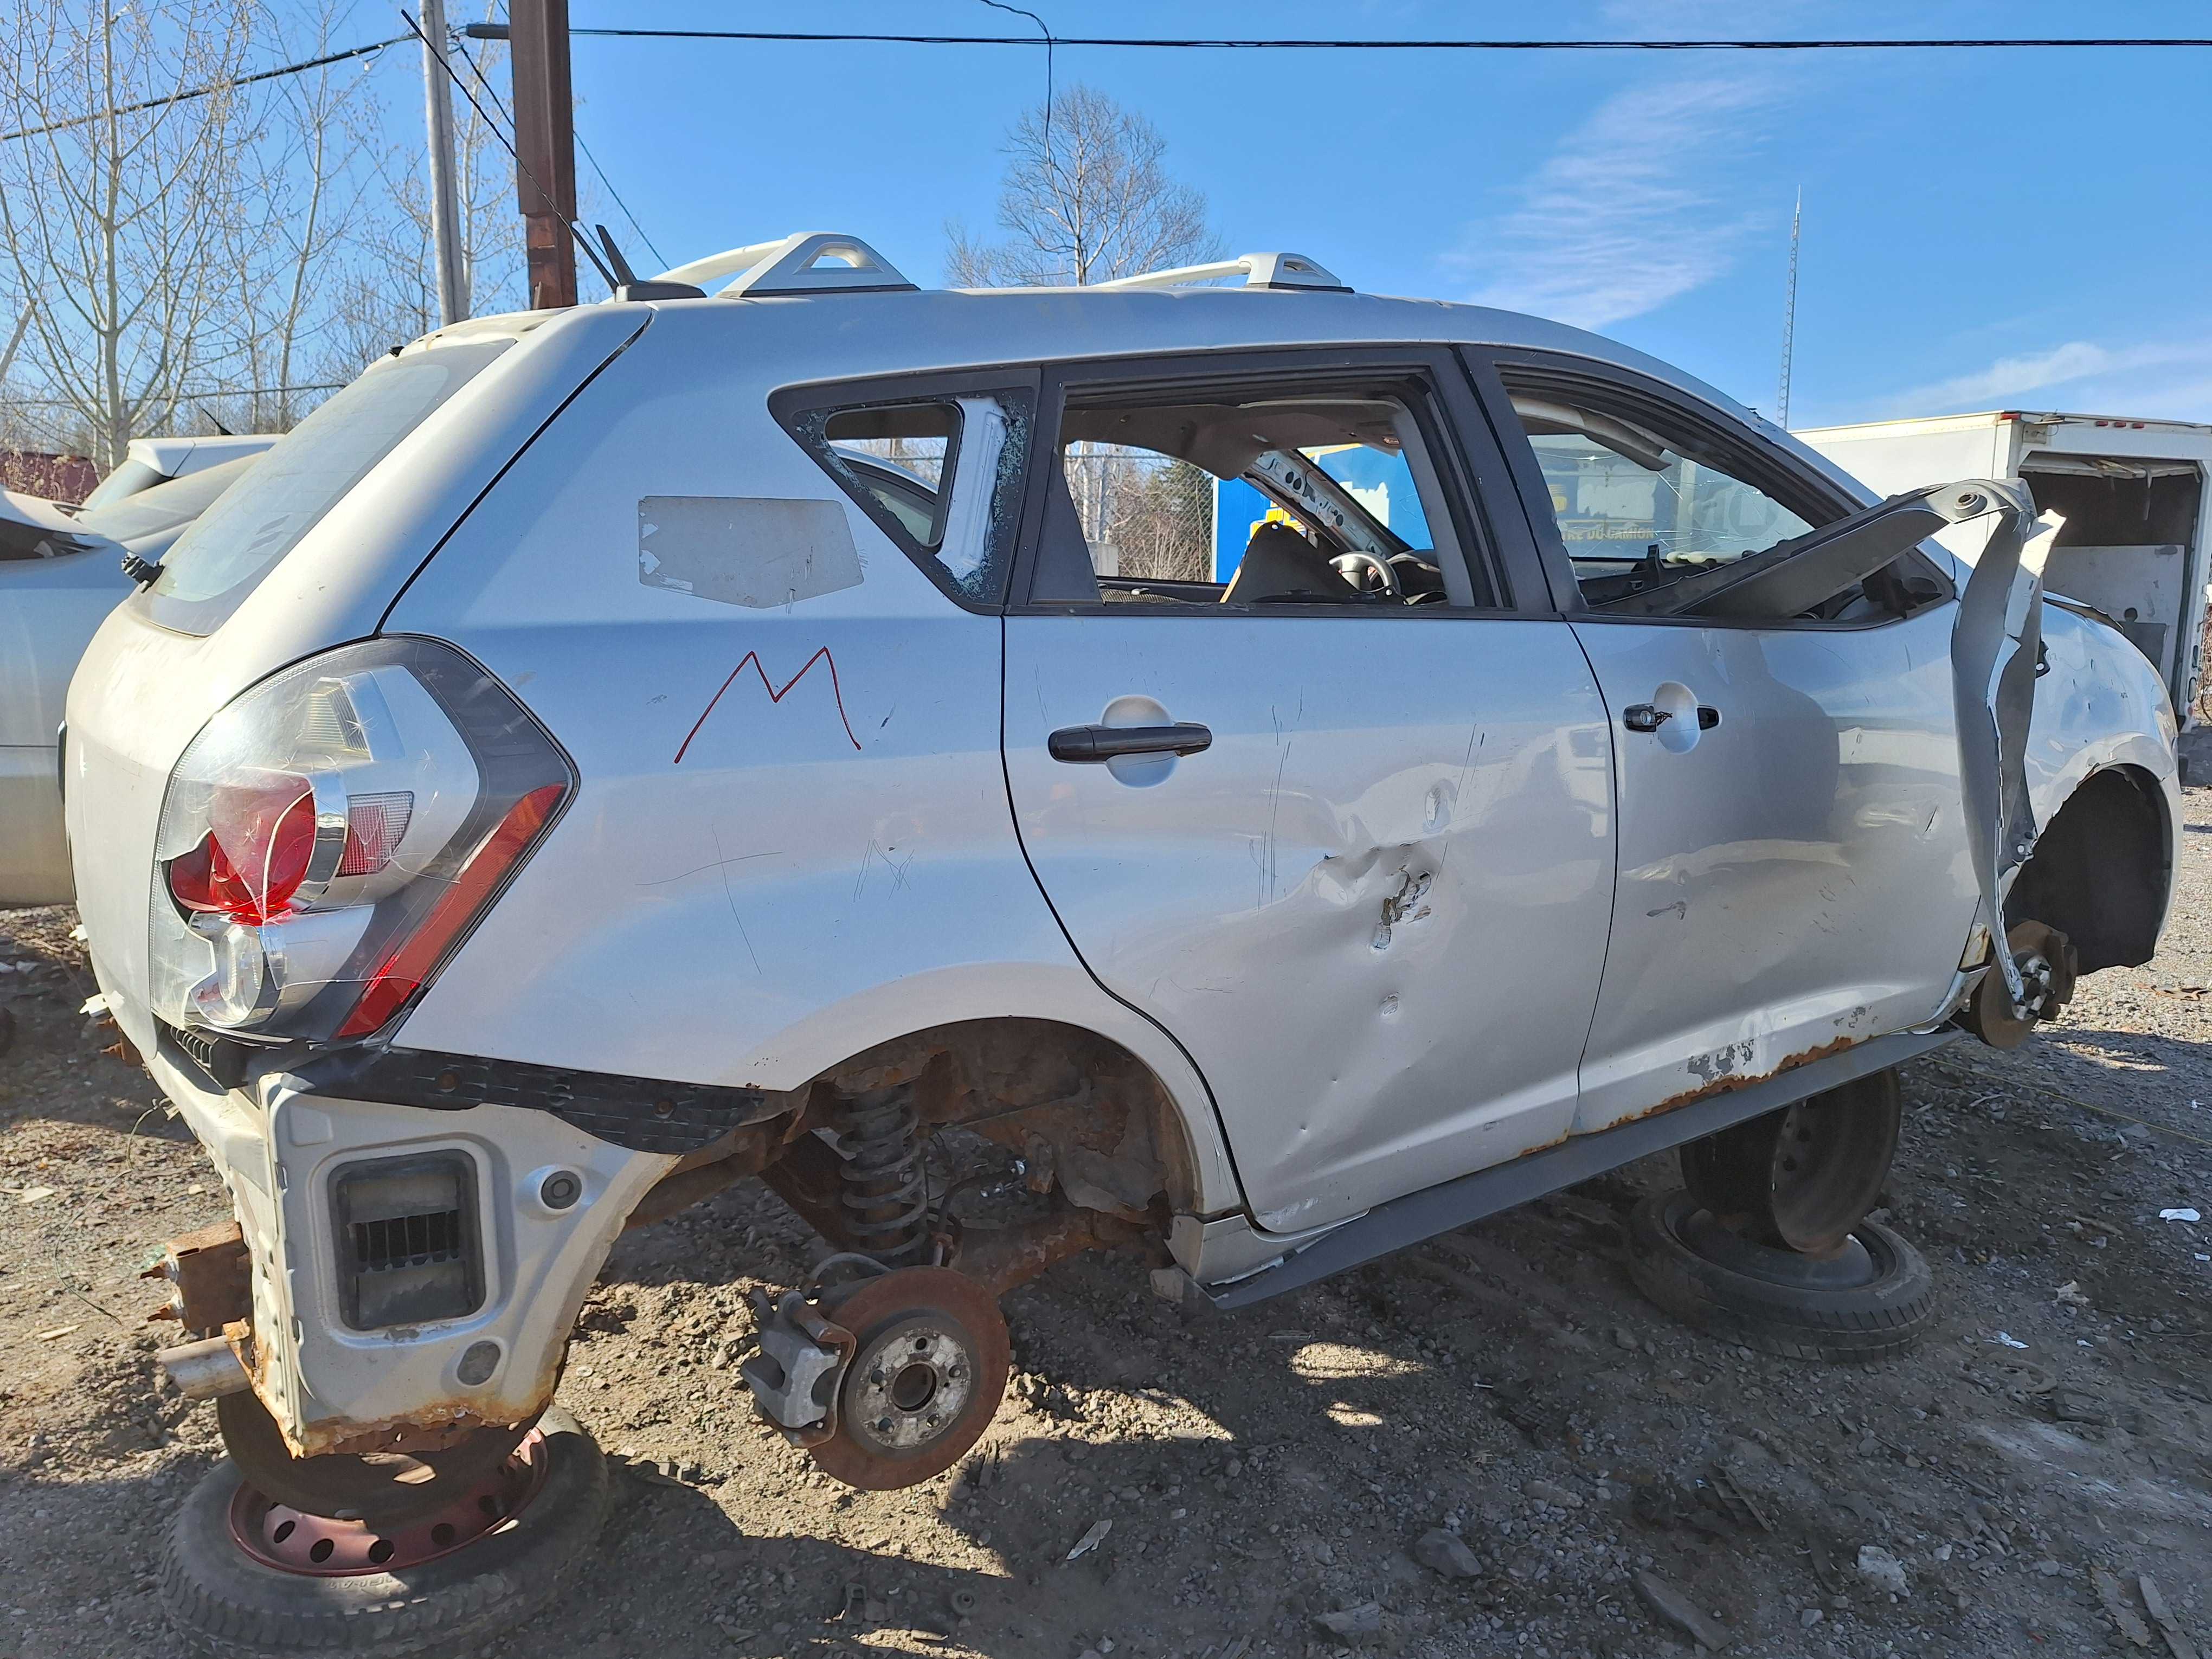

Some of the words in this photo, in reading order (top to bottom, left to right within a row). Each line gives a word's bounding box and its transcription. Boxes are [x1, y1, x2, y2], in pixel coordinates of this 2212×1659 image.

[1587, 529, 1605, 541] DU
[1607, 528, 1654, 540] CAMION
[674, 646, 861, 764] M
